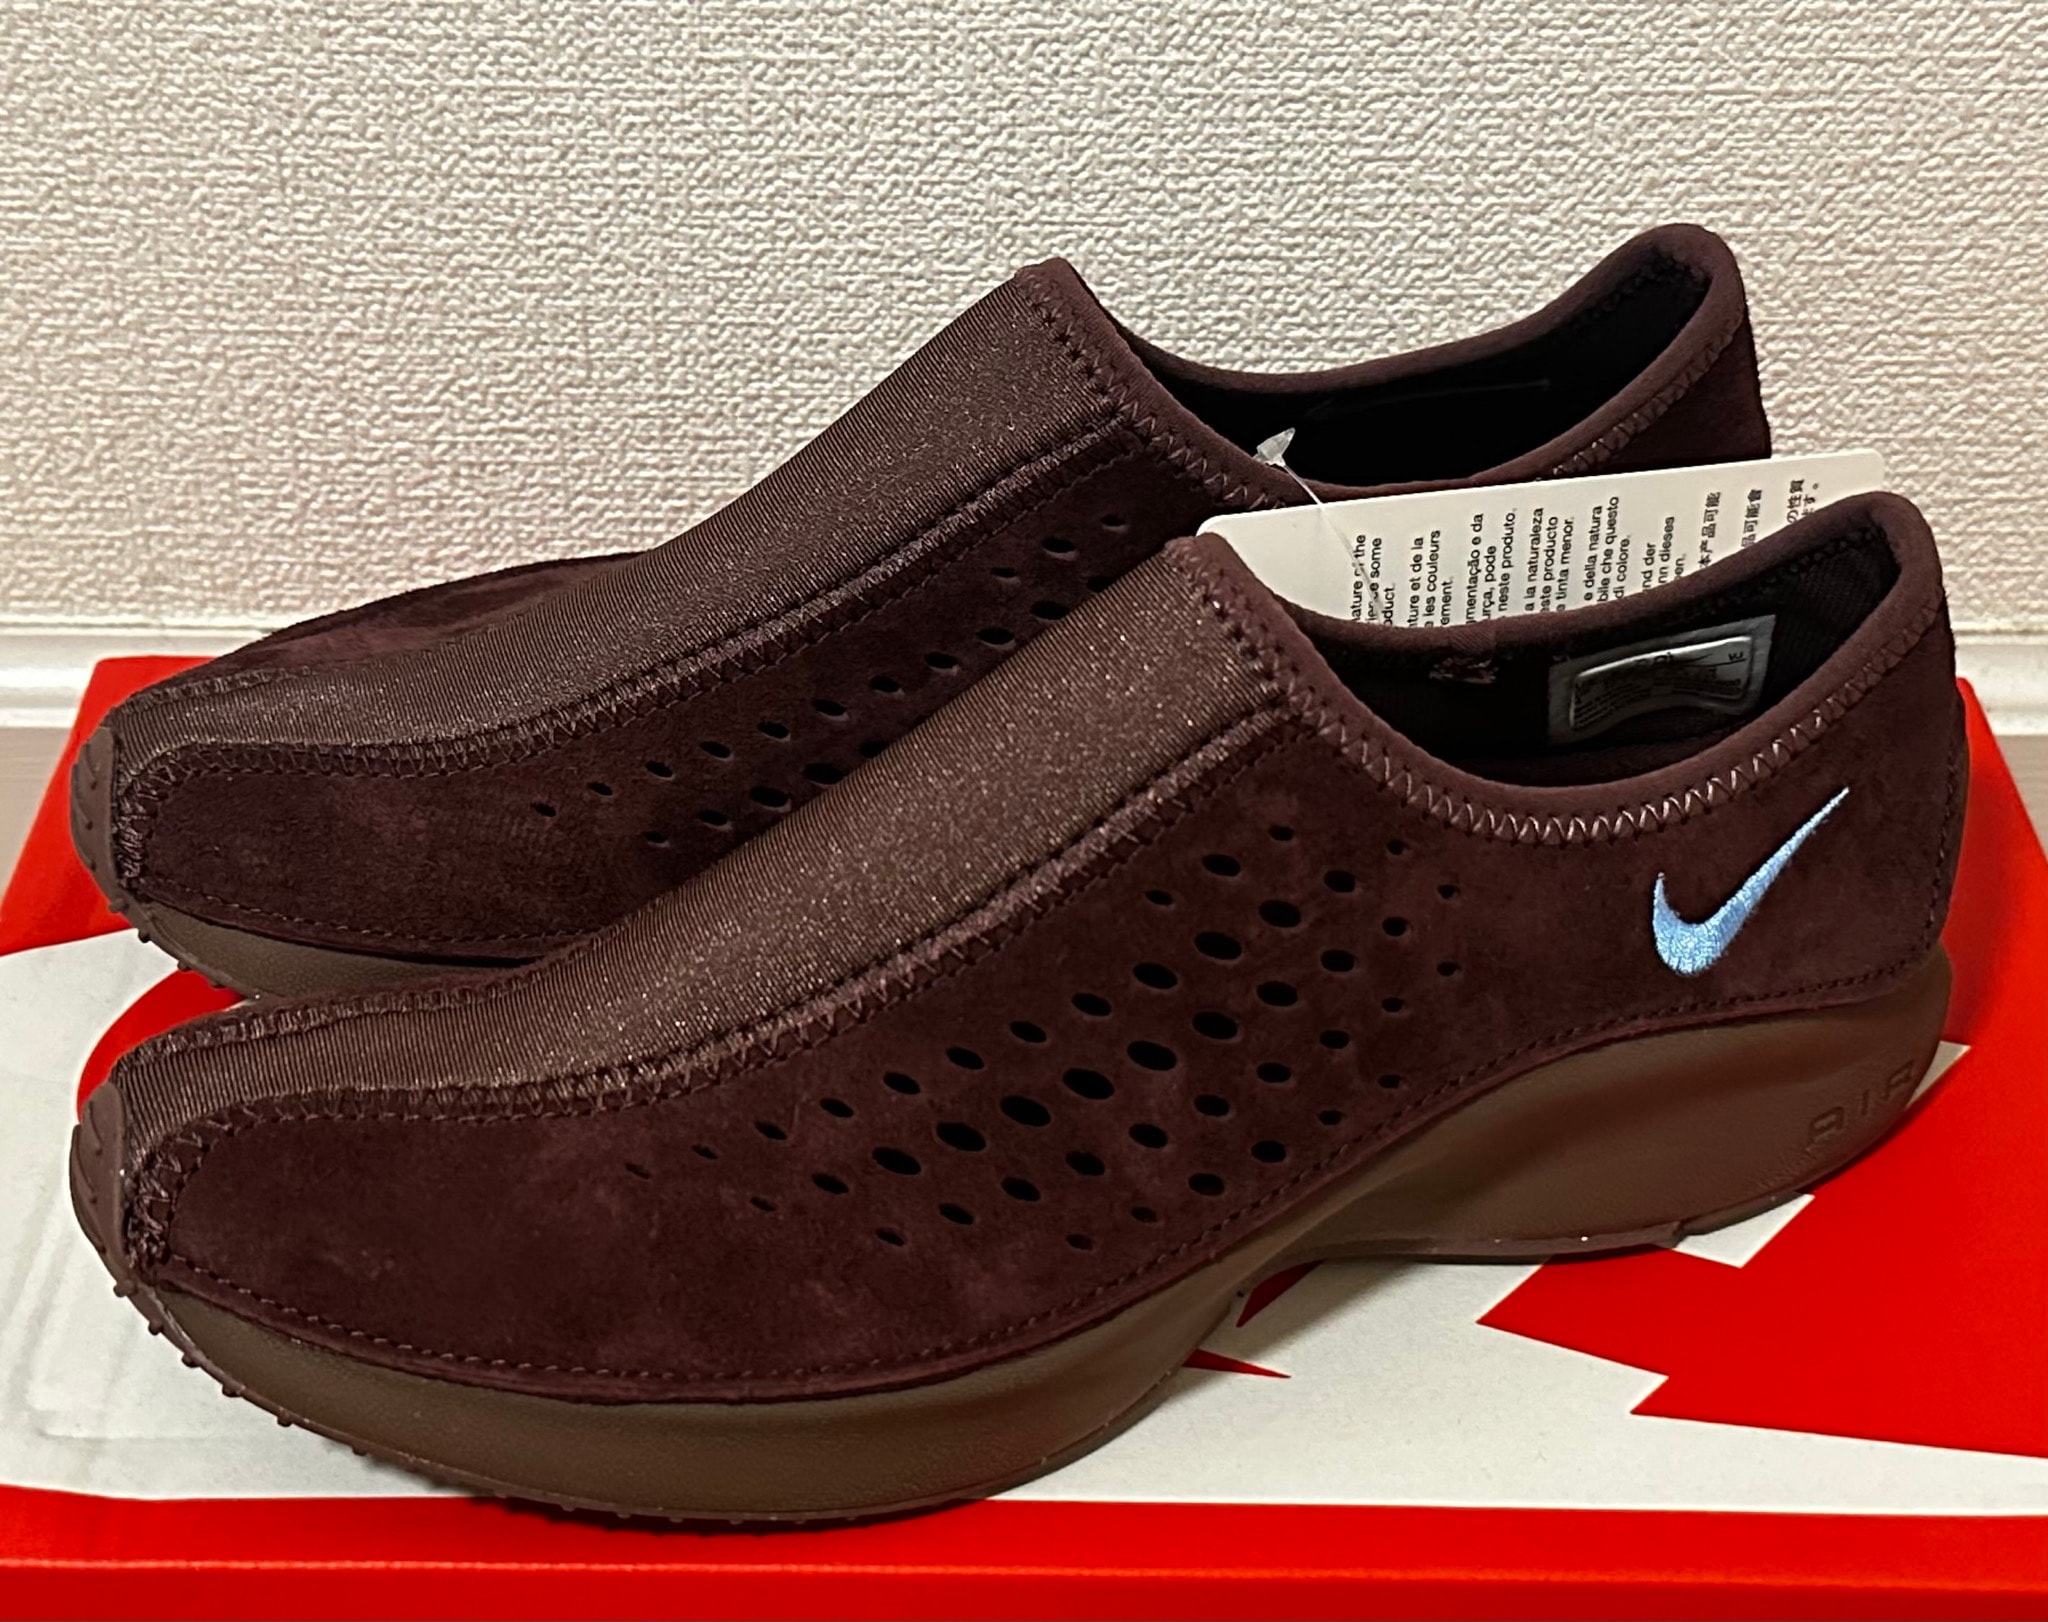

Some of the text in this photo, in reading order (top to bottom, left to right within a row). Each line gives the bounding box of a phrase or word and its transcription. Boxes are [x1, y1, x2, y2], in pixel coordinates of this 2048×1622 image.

[1470, 514, 1483, 532] da
[1472, 537, 1481, 545] e
[1561, 517, 1574, 564] menor.
[1604, 497, 1619, 544] questo
[1659, 517, 1674, 561] dieses
[1353, 535, 1365, 558] the
[1371, 538, 1382, 578] some
[1411, 537, 1423, 550] la
[1411, 554, 1422, 572] de
[1426, 530, 1440, 592] couleurs
[1484, 546, 1496, 582] pode
[1498, 508, 1517, 611] neste produto.
[1524, 508, 1543, 611] a la naturaleza
[1543, 517, 1558, 581] producto
[1583, 506, 1602, 601] e della natura
[1601, 548, 1613, 574] che
[1411, 577, 1421, 591] et
[1555, 569, 1569, 599] tinta
[1613, 535, 1630, 598] di colore.
[1642, 543, 1656, 592] nd der
[1424, 596, 1435, 616] les
[1806, 1058, 1916, 1147] AIR
